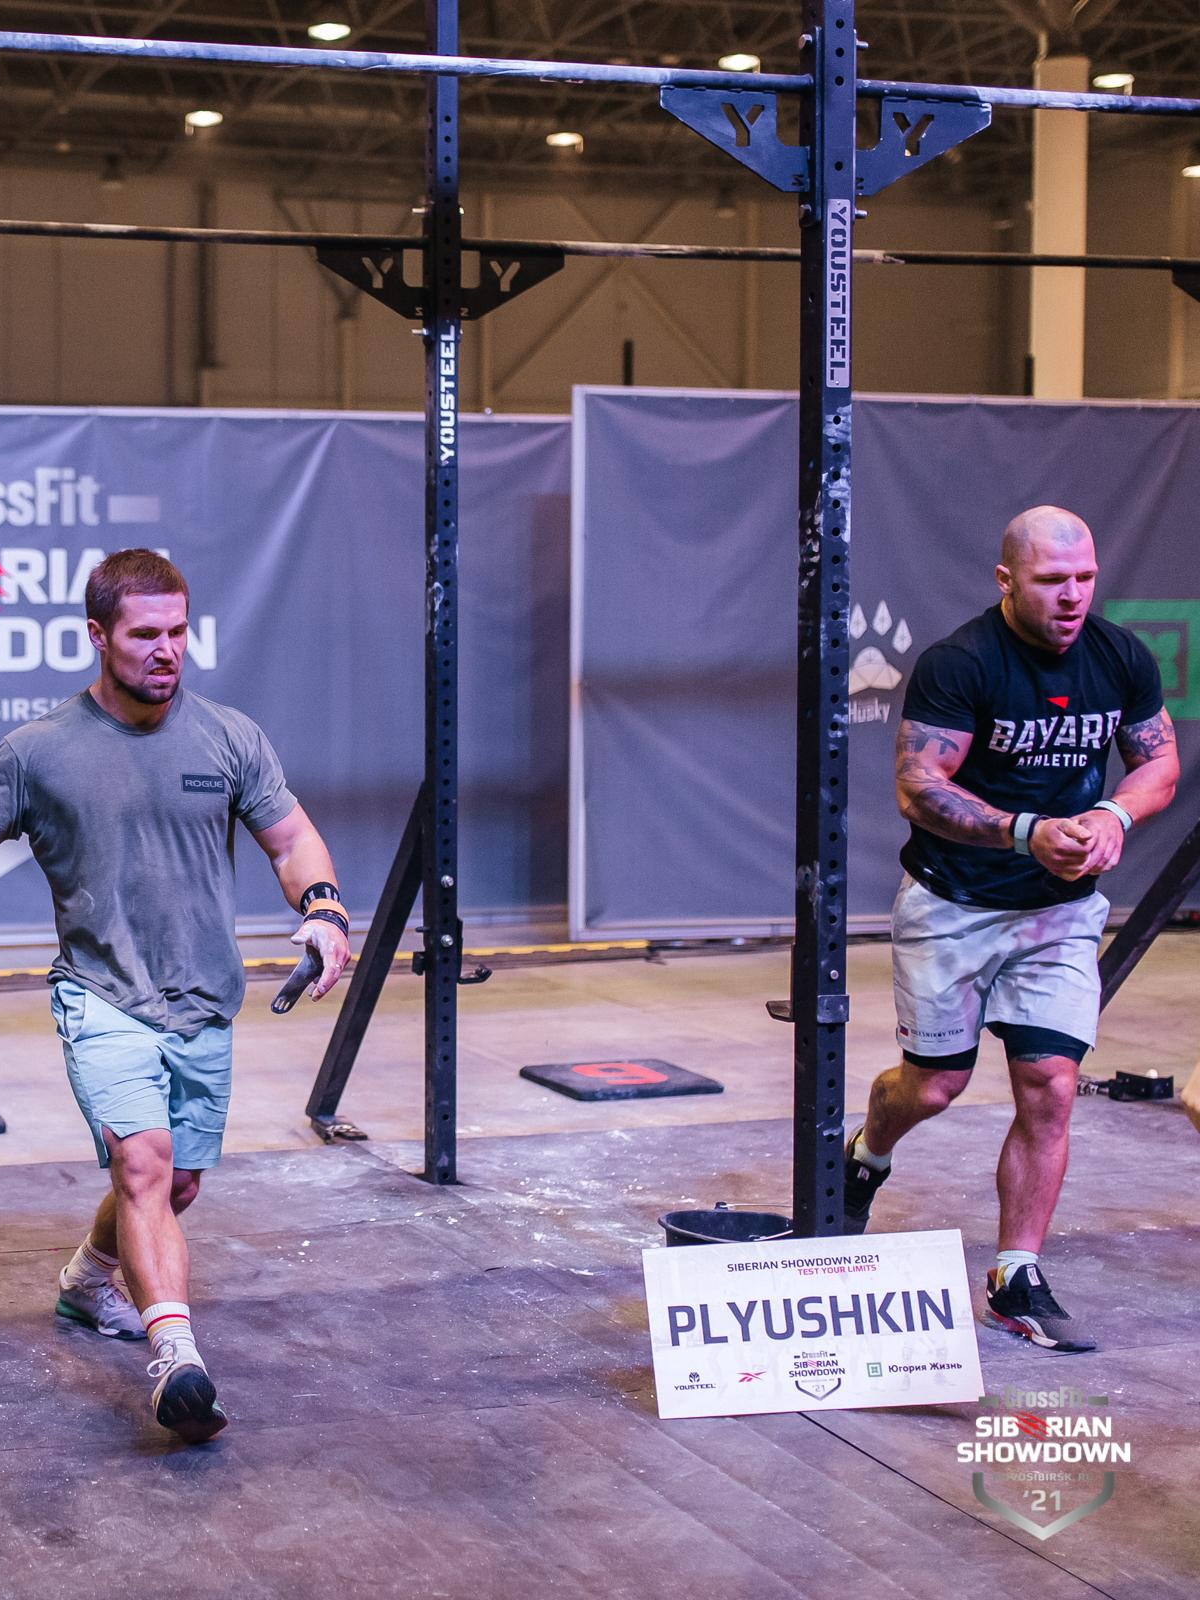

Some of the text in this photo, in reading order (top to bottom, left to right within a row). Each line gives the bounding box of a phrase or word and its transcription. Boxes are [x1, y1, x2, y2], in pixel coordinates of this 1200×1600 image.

[830, 206, 847, 381] YOUSTEEL
[440, 325, 456, 466] YOUSTEEL
[1016, 753, 1088, 768] ATHLETIC
[185, 779, 224, 788] ROGUE
[727, 1254, 880, 1273] SIBERIAN SHOWDOWN 2021
[797, 1264, 877, 1276] TEST YOUR LIMITS
[667, 1288, 955, 1347] PLYUSHKIN
[794, 1359, 839, 1370] SIBRIAN
[888, 1362, 963, 1374] Югория Жизнь
[789, 1368, 846, 1378] SHOWDOWN
[674, 1383, 717, 1391] YOUSTEEL
